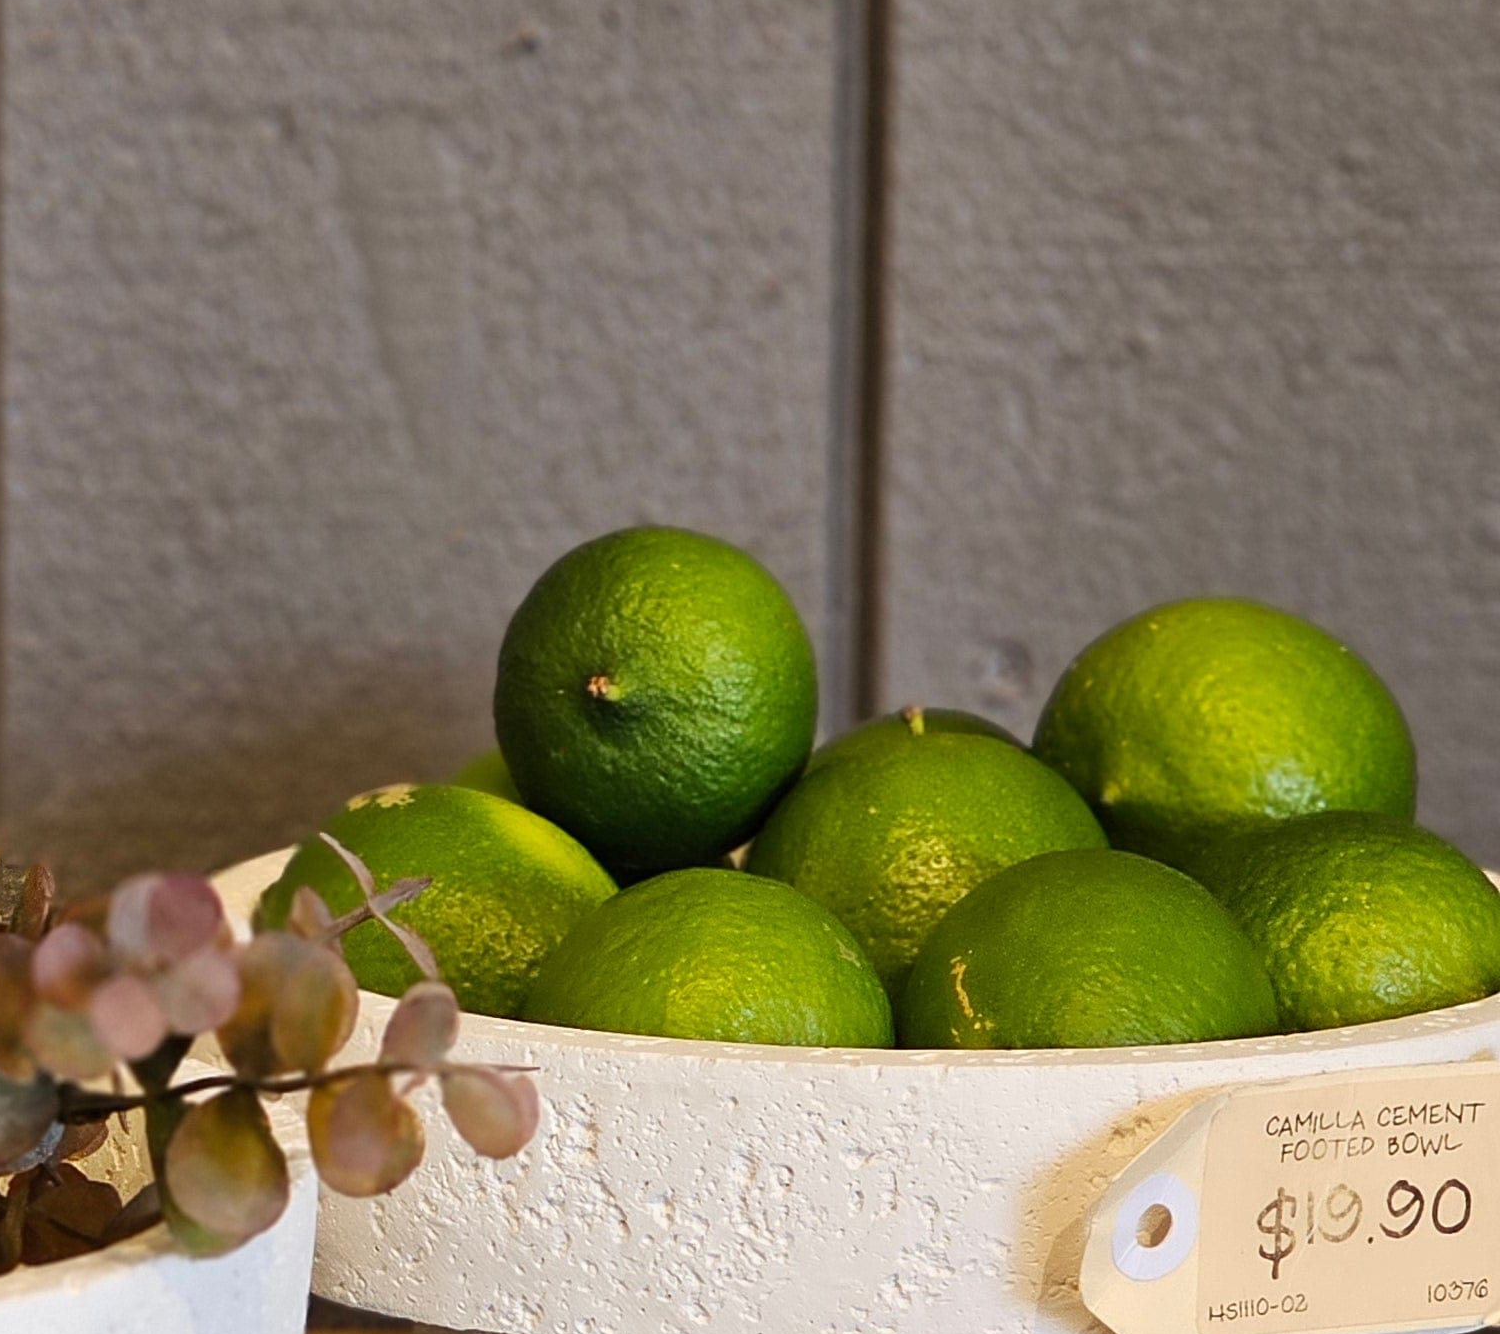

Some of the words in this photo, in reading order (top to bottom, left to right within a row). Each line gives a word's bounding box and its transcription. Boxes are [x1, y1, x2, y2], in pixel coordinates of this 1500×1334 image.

[1266, 1111, 1365, 1138] CAMILLA
[1377, 1102, 1485, 1127] CEMENT
[1280, 1136, 1374, 1163] FOOTED
[1388, 1132, 1462, 1157] BOWL
[1257, 1179, 1471, 1279] $19.90
[1428, 1279, 1488, 1303] 10376
